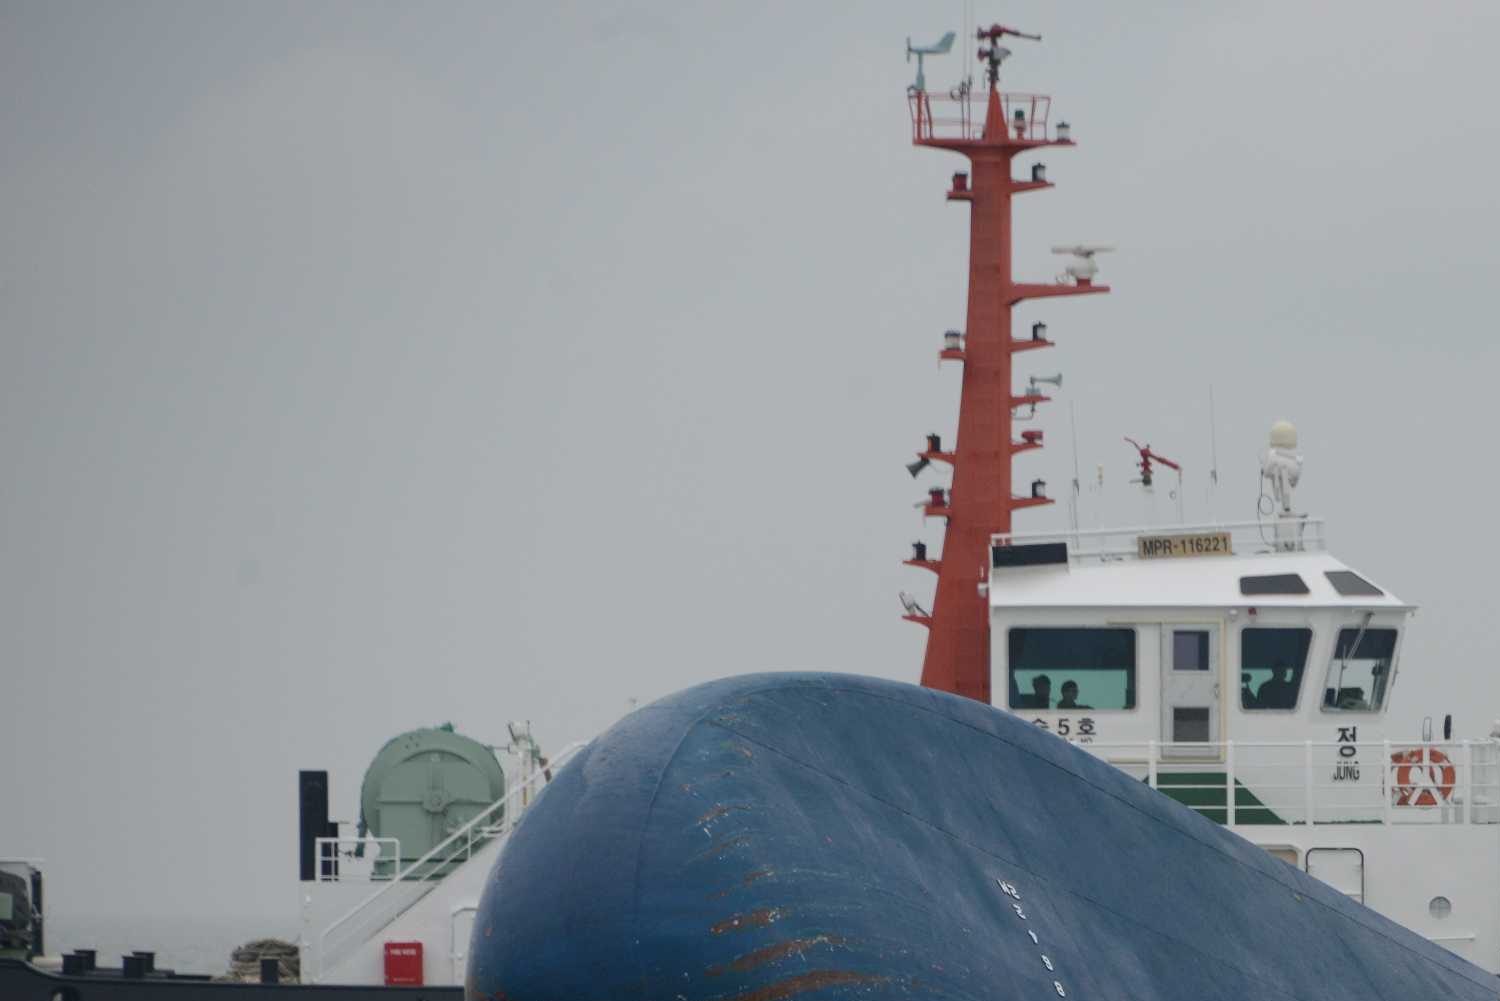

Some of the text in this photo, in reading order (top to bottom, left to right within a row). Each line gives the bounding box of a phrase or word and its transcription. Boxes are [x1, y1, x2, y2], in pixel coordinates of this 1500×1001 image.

[1143, 537, 1228, 556] MPR-116221
[1337, 726, 1357, 758] 정
[1333, 760, 1360, 781] JUNG
